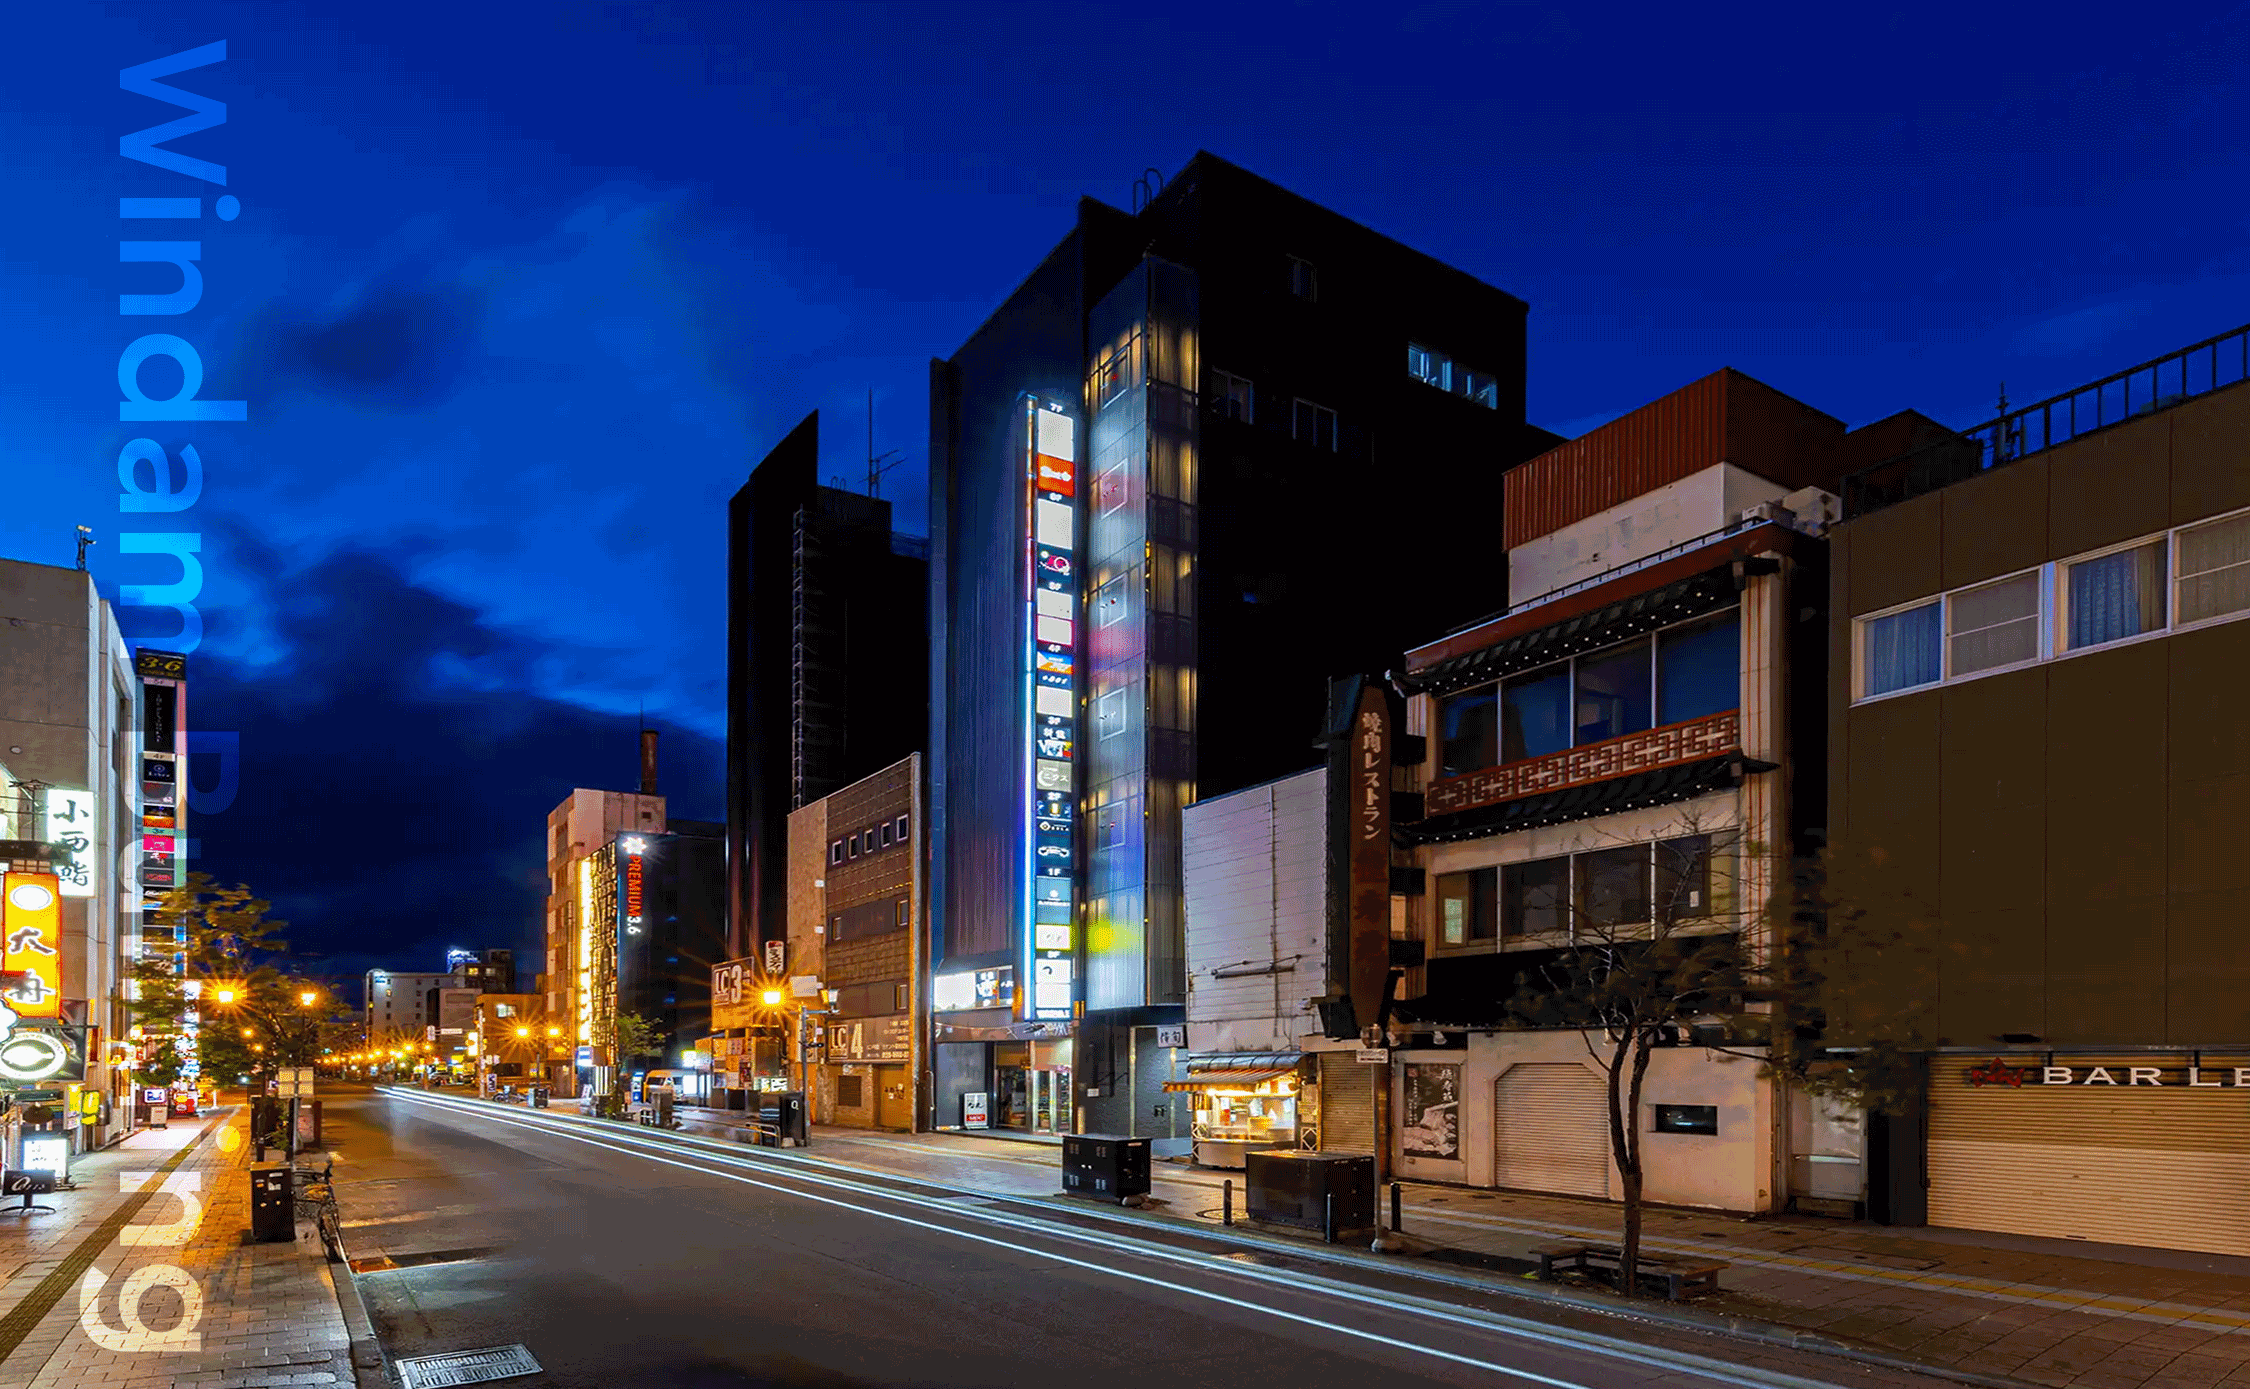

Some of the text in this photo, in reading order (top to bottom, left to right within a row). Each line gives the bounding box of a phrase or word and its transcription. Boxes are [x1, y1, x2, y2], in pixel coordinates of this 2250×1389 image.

[1362, 712, 1382, 840] 焼肉レストラン
[626, 855, 643, 916] PREMIUM
[1047, 868, 1061, 876] 1F
[731, 964, 742, 1004] 3
[851, 1023, 863, 1059] 4
[2042, 1066, 2163, 1086] BAR
